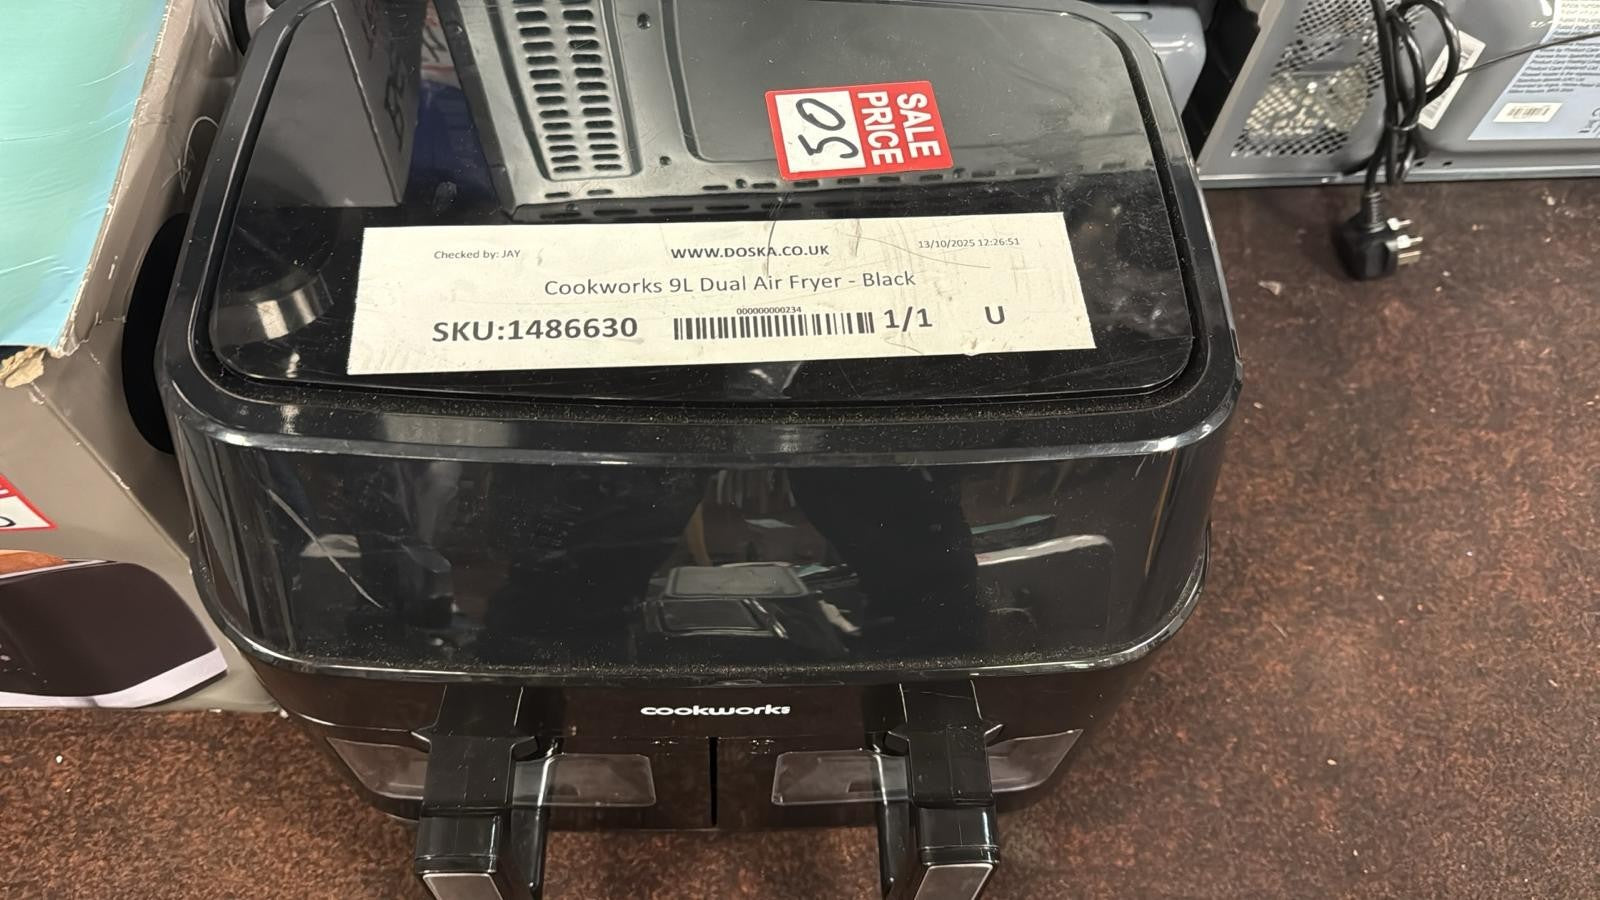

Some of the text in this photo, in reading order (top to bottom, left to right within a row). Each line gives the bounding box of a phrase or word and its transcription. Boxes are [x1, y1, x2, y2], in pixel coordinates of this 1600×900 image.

[796, 98, 859, 159] 50
[857, 91, 904, 166] PRICE
[896, 93, 942, 158] SALE
[433, 249, 521, 261] Checked by: JAY
[671, 243, 830, 259] WWW.DOSKA.CO.UK
[917, 237, 1020, 250] 13/10/2025 12:26:51
[544, 278, 662, 296] Cookworks
[668, 278, 693, 294] 9L
[700, 275, 746, 293] Dual
[753, 274, 782, 291] Air
[789, 272, 842, 294] Fryer
[862, 270, 917, 287] Black
[432, 305, 1006, 342] SKU:1486630 1/1 U
[640, 704, 791, 716] cookworks
